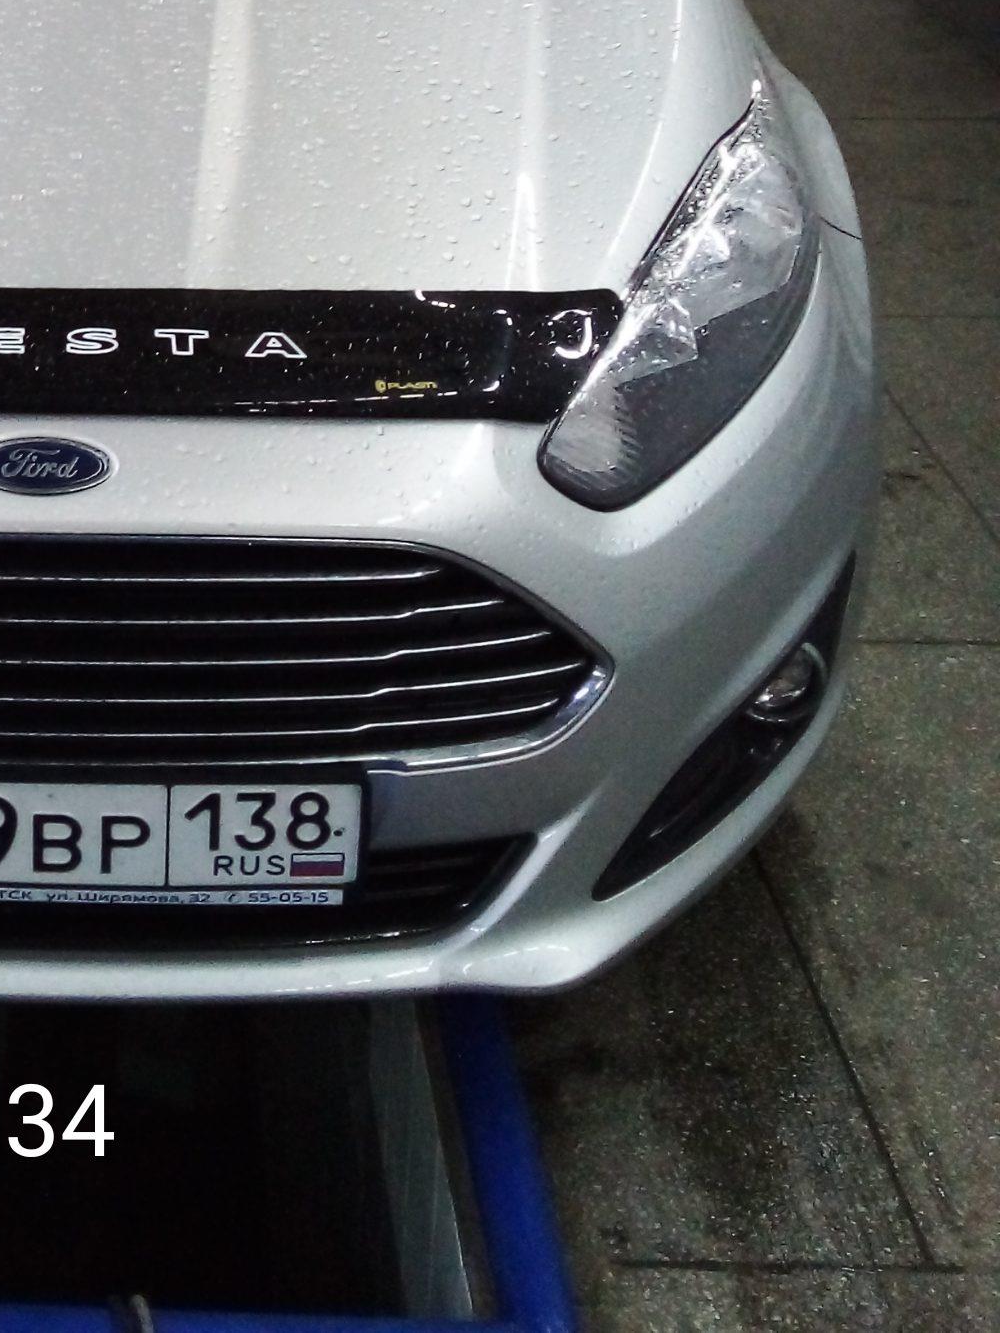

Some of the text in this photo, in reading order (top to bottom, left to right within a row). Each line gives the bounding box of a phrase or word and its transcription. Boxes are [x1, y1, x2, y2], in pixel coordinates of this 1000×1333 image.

[1, 448, 81, 478] Ford
[184, 791, 332, 852] 138
[213, 854, 286, 877] RUS
[248, 891, 329, 903] 55-05-15
